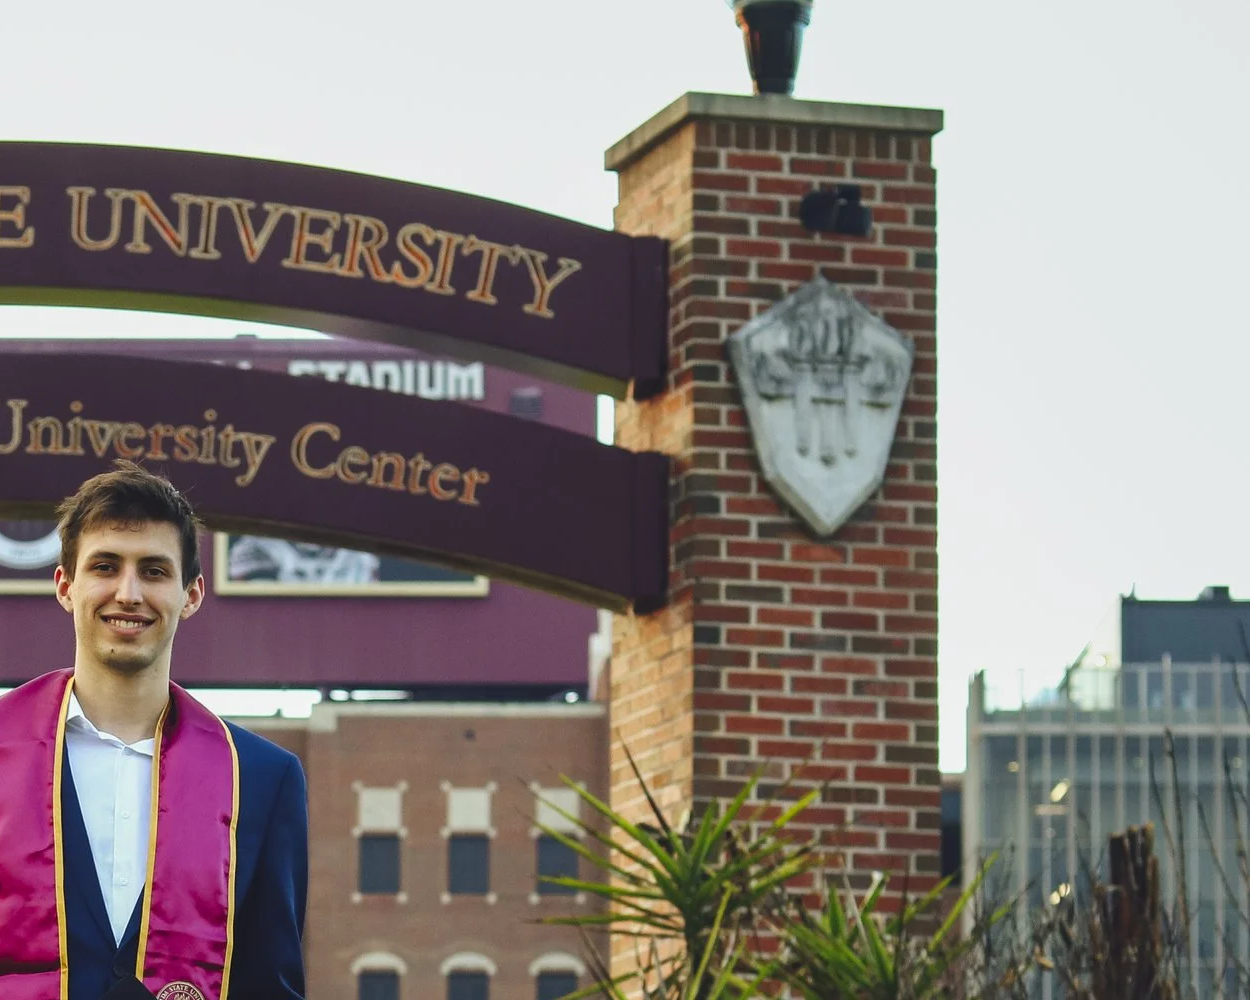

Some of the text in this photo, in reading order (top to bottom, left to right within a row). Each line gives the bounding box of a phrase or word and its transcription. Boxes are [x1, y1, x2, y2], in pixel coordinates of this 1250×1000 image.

[67, 185, 581, 318] UNIVERSITY
[290, 422, 490, 505] Center
[168, 984, 189, 992] STATE
